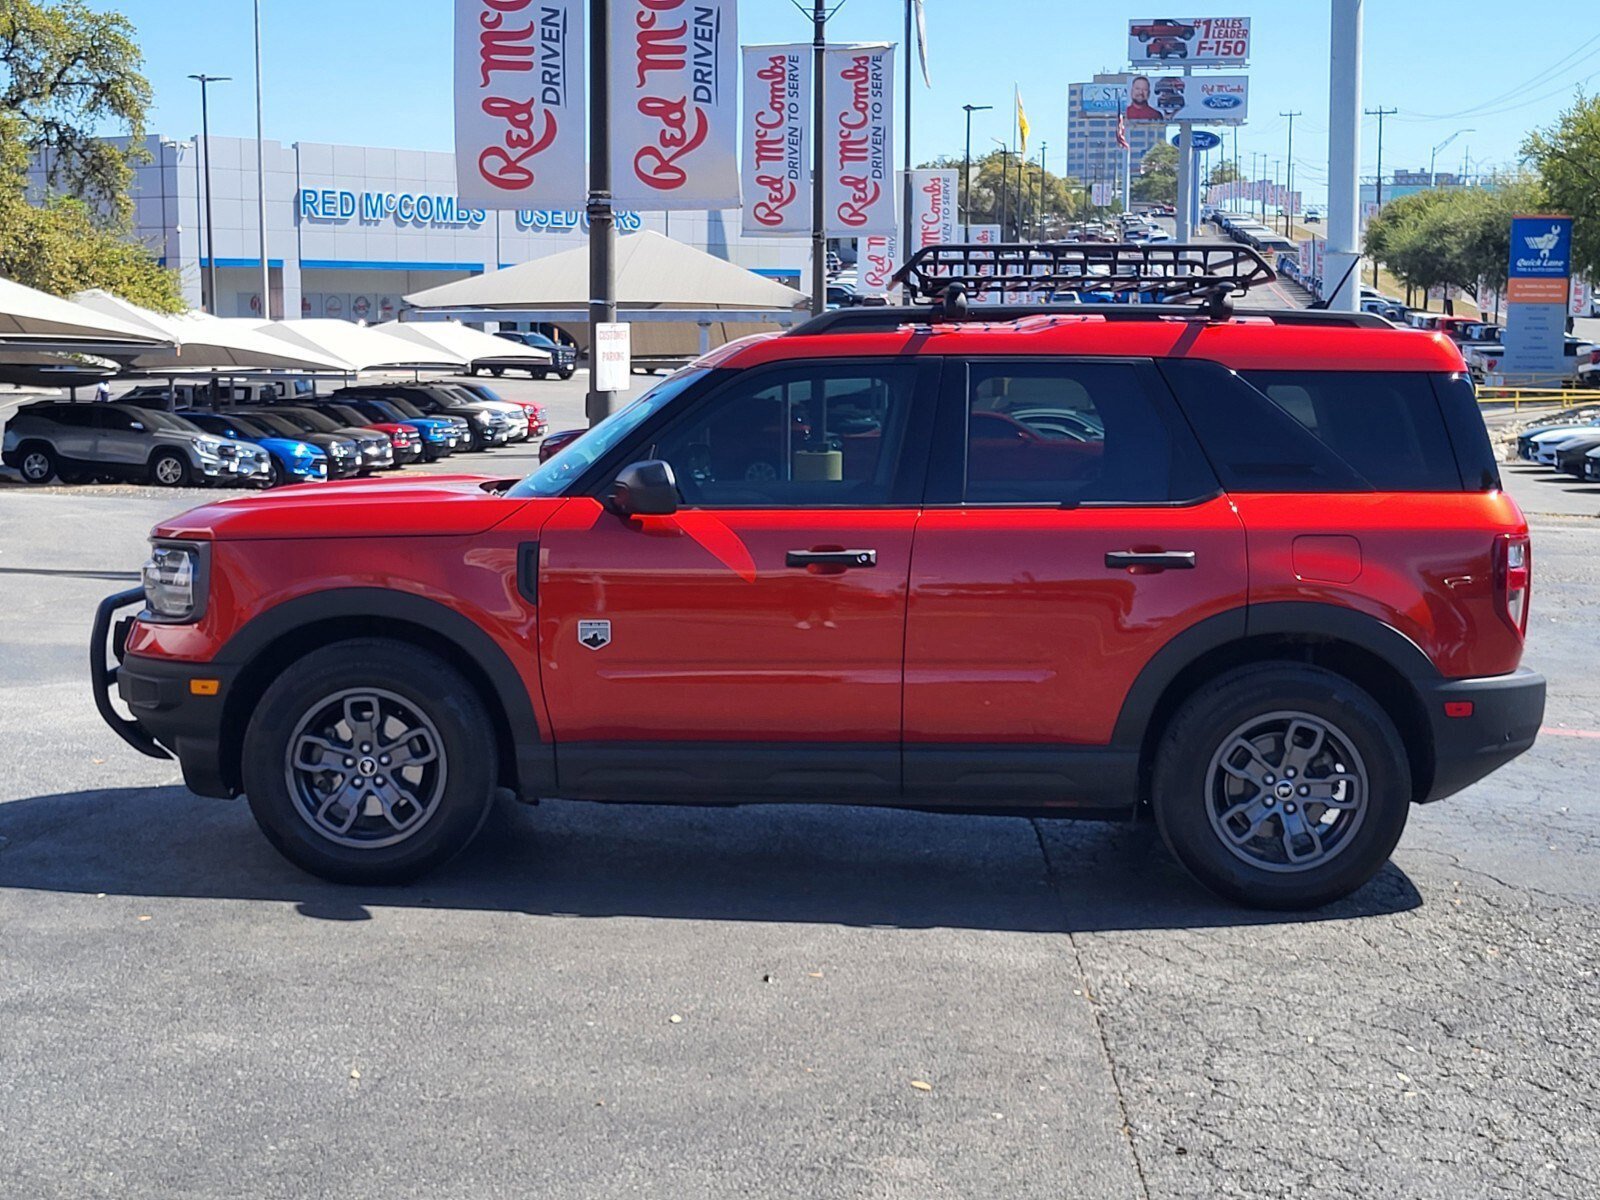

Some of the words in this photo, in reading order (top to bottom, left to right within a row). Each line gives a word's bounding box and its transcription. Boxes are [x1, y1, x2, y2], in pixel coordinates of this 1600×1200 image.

[1193, 19, 1211, 39] #1
[1214, 19, 1242, 28] SALES
[1196, 40, 1246, 56] F-150
[1212, 29, 1248, 39] LEADER
[541, 6, 561, 106] DRIVEN
[693, 6, 713, 104] DRIVEN
[872, 55, 883, 98] SERVE
[788, 55, 800, 99] SERVE
[755, 55, 786, 170] McCombs
[788, 102, 799, 123] TO
[838, 55, 870, 170] McCombs
[872, 102, 883, 122] TO
[478, 96, 557, 190] Red
[634, 95, 708, 190] Red
[788, 126, 800, 180] DRIVEN
[872, 126, 884, 180] DRIVEN
[302, 189, 355, 217] RED
[521, 209, 579, 227] USED
[753, 175, 796, 226] Red
[837, 175, 880, 227] Red
[943, 208, 950, 221] TO
[865, 253, 893, 287] Red
[1516, 258, 1541, 267] Quick
[1542, 259, 1564, 267] Lane
